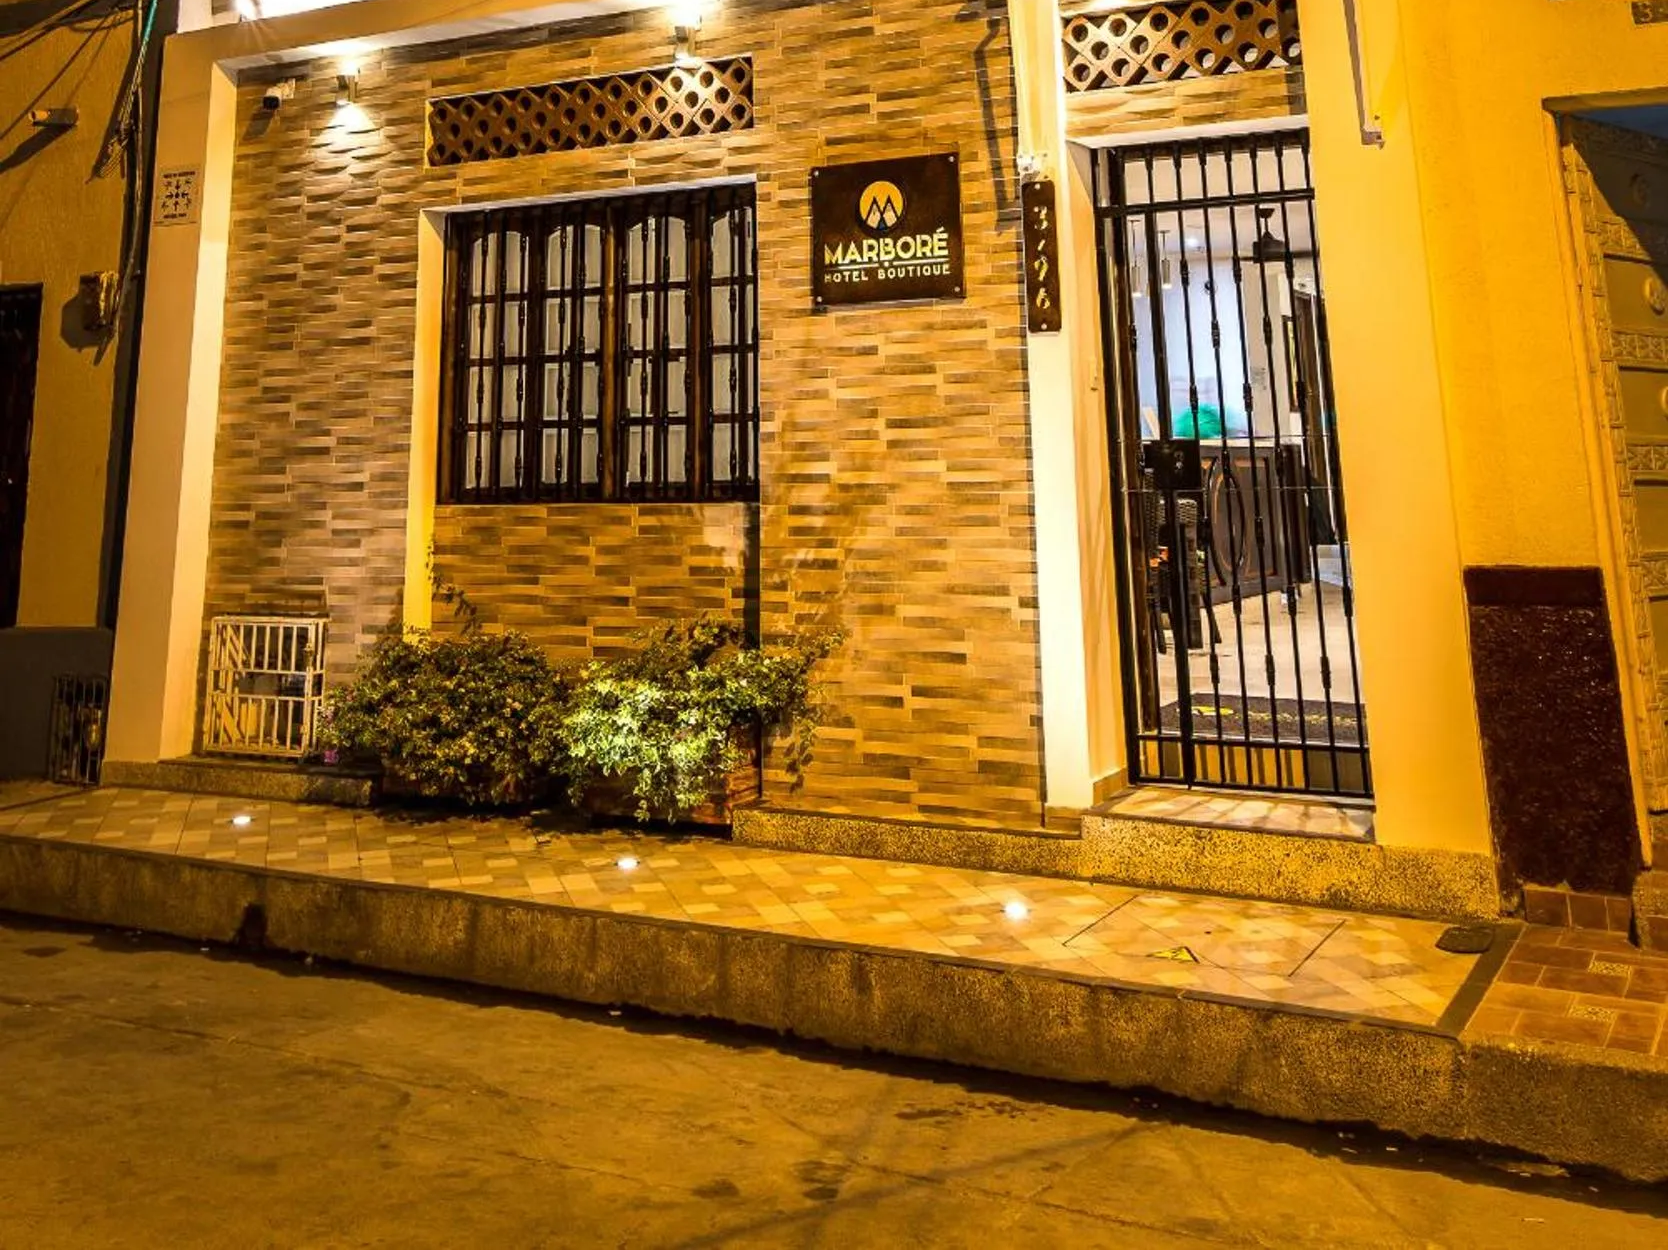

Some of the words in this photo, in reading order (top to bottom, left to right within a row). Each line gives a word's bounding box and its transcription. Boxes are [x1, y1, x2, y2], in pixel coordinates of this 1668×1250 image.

[823, 226, 950, 266] MARBORÉ
[824, 270, 869, 284] HOTEL
[877, 264, 951, 279] BOUTIQUE
